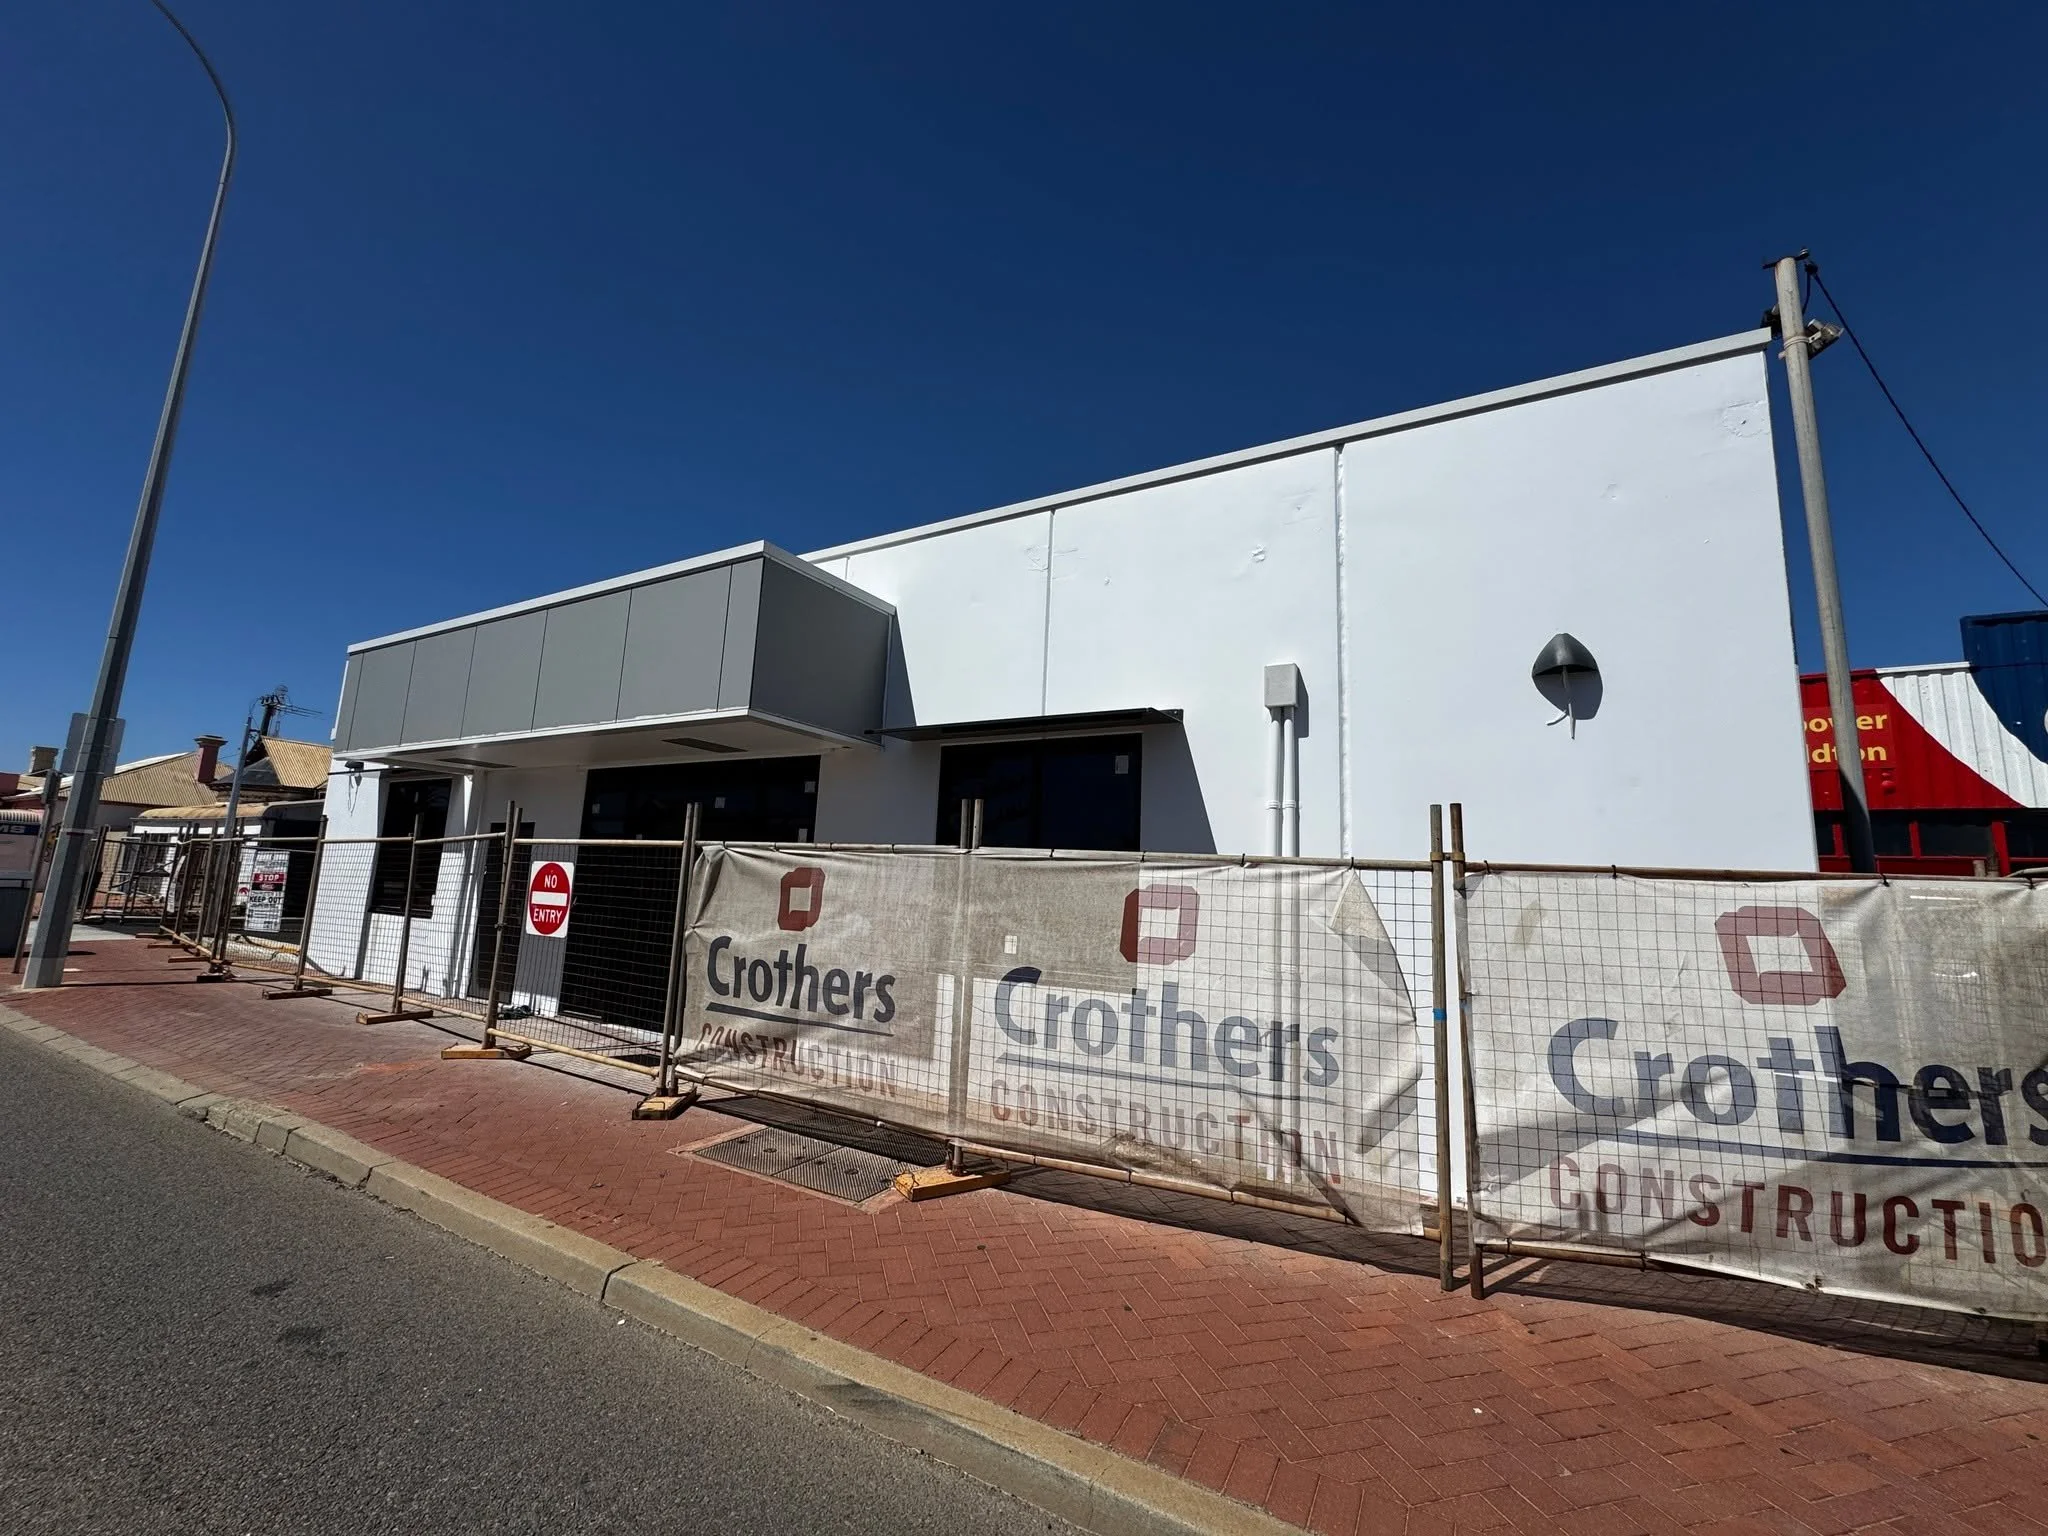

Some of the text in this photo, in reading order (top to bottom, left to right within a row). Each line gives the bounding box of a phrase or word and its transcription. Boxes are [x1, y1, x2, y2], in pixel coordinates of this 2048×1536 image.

[258, 874, 281, 882] STOP
[544, 874, 558, 889] NO
[533, 908, 563, 924] ENTRY
[707, 935, 896, 1023] Crothers
[995, 966, 1339, 1087] Crothers
[1547, 1017, 2048, 1146] Crothers
